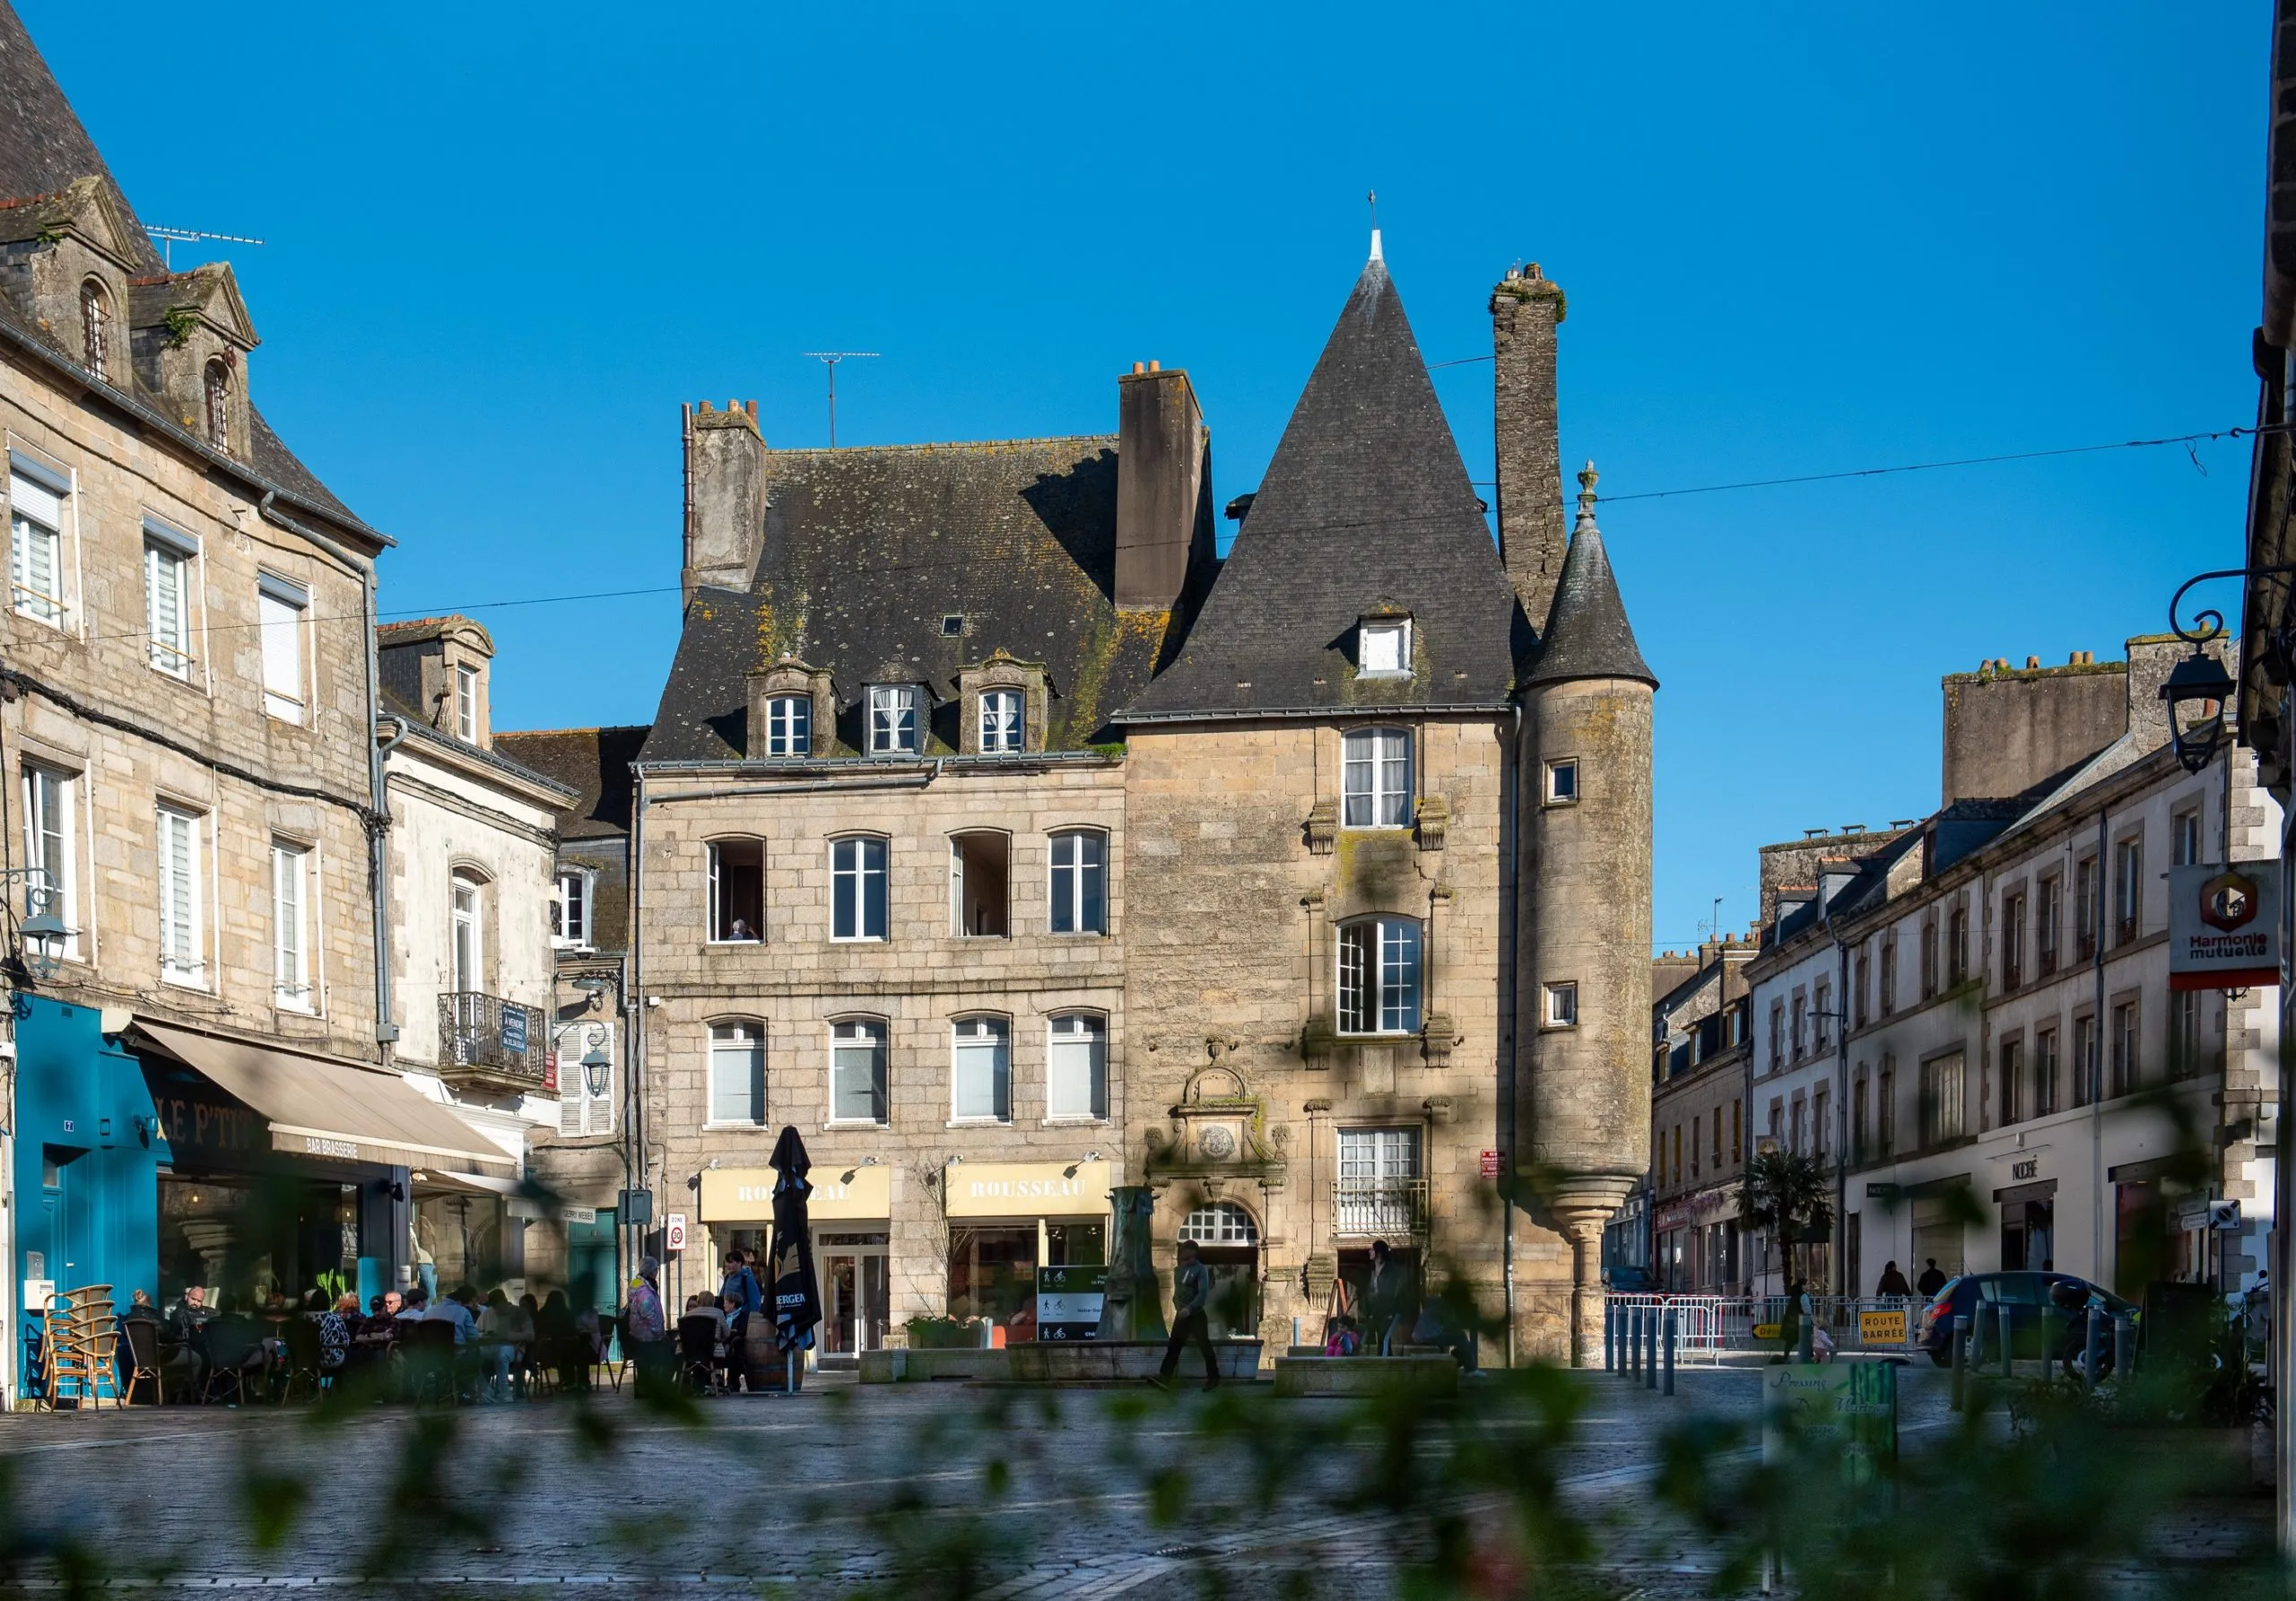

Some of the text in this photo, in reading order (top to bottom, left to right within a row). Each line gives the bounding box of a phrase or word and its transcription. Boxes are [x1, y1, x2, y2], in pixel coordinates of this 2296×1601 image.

[2190, 933, 2267, 948] Harmonie
[2190, 943, 2267, 959] mutuelle
[306, 1137, 321, 1154] BAR
[322, 1139, 358, 1160] BRASSERIE
[738, 1185, 850, 1201] ROEAU
[970, 1179, 1085, 1197] ROUSSEAU
[578, 1211, 594, 1221] WEBER
[1865, 1317, 1900, 1327] ROUTE
[1863, 1327, 1905, 1338] BARRÉE
[1770, 1371, 1828, 1391] Pressing
